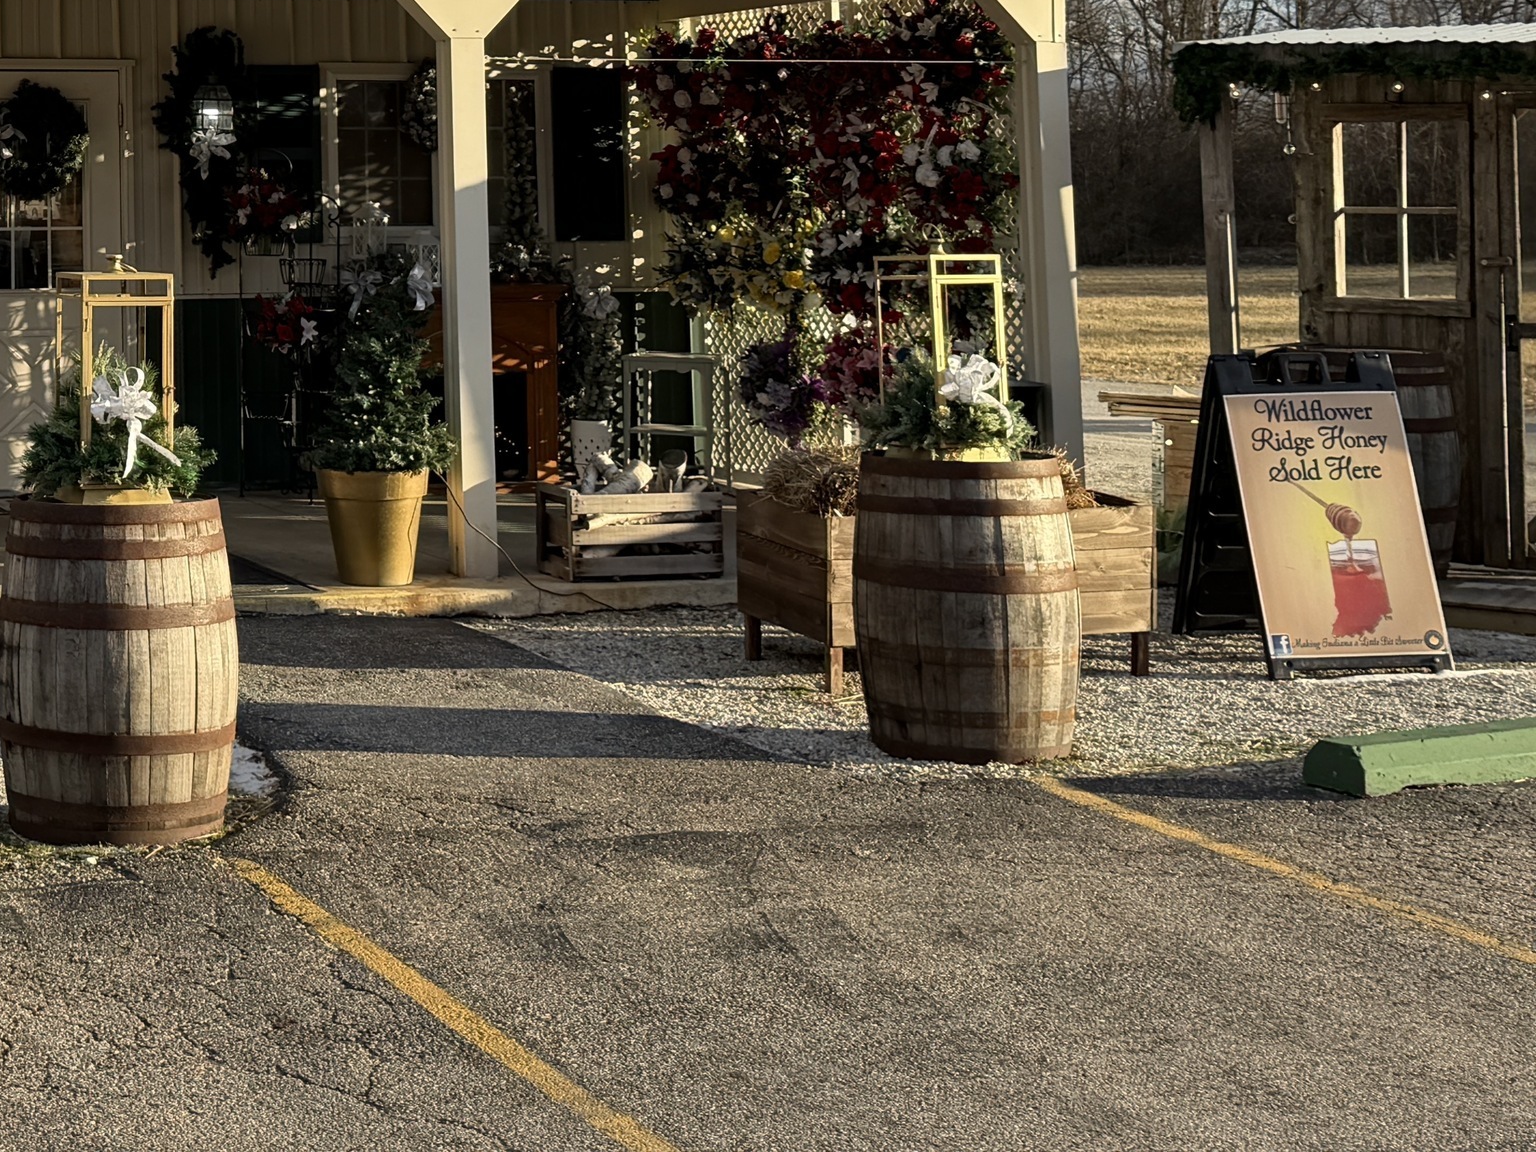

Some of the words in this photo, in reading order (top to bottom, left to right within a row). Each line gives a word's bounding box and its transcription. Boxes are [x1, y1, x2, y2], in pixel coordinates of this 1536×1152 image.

[1254, 398, 1373, 423] Wildflower
[1251, 427, 1315, 456] Ridge
[1317, 425, 1388, 454] Honey
[1268, 457, 1323, 482] Sold
[1324, 455, 1382, 481] Here
[1292, 637, 1322, 650] Making
